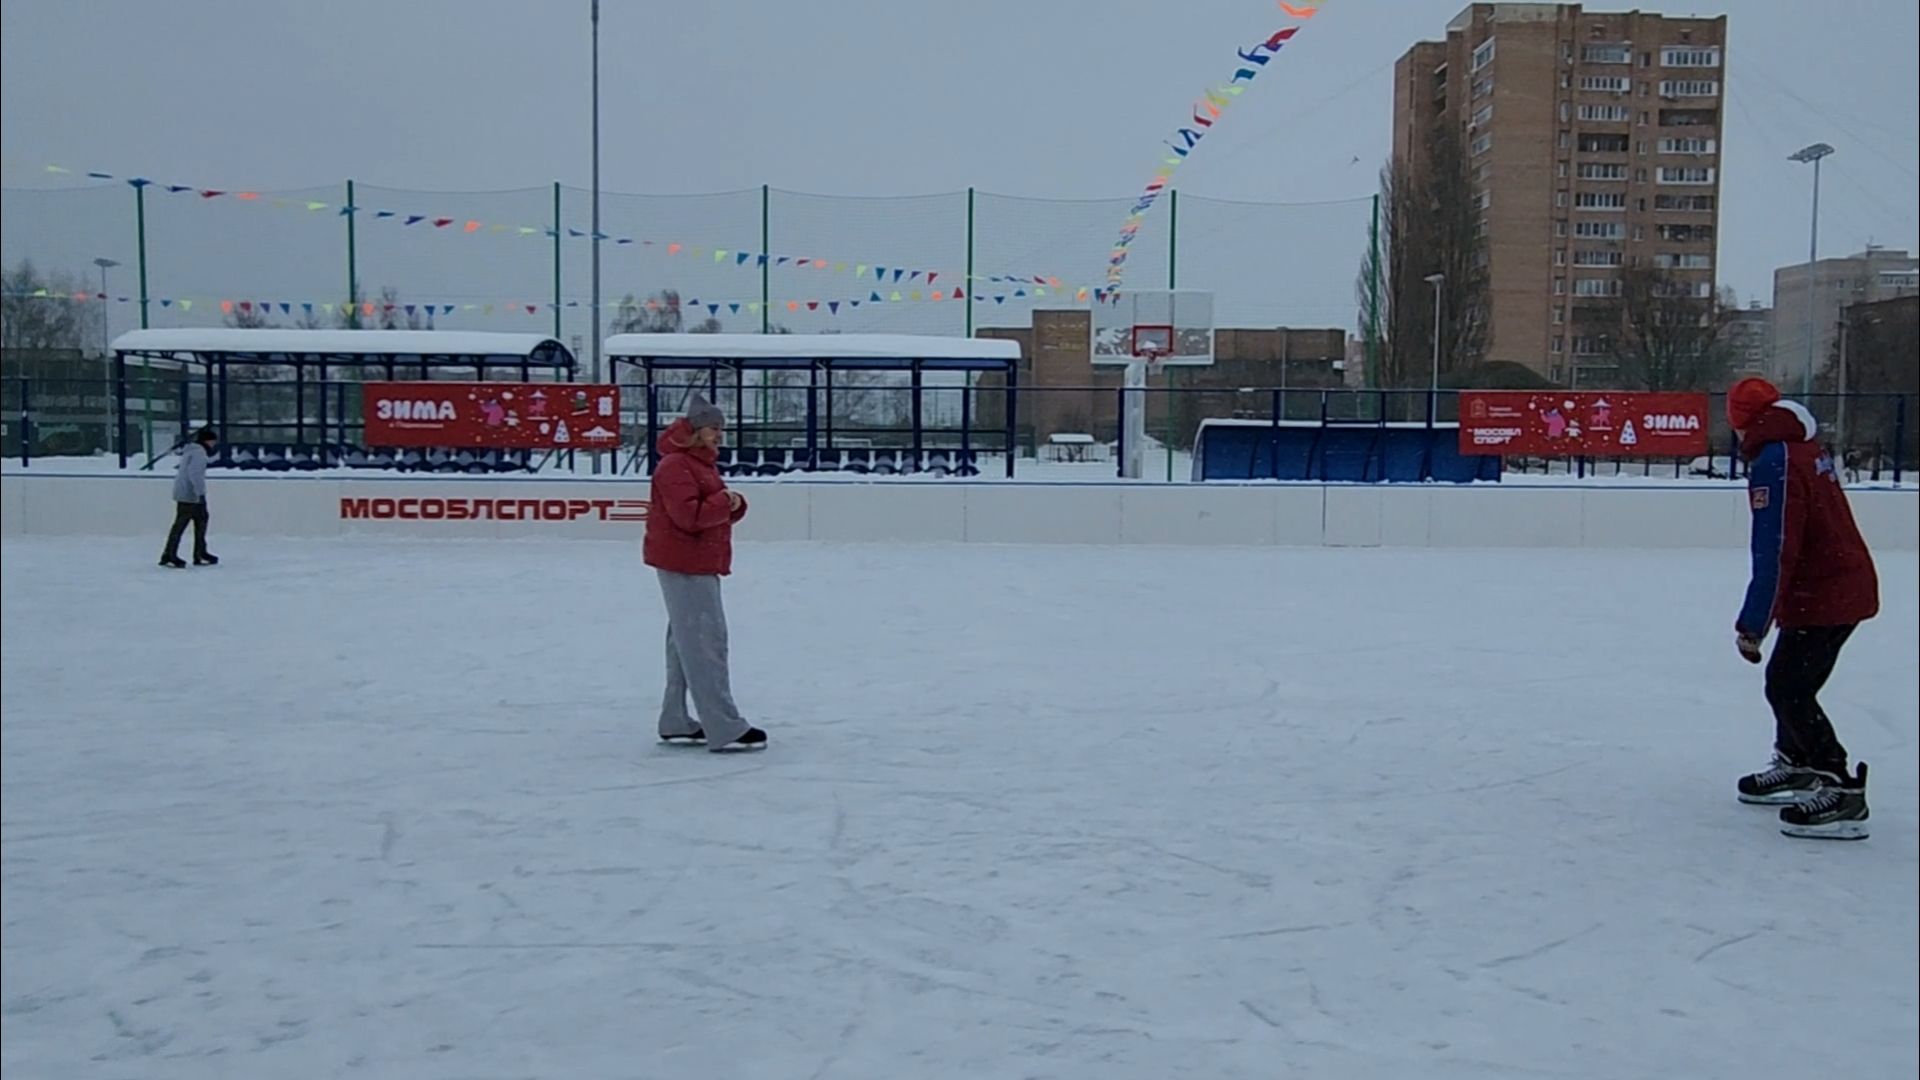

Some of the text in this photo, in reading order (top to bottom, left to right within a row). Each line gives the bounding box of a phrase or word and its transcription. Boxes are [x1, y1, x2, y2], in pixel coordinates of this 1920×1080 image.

[376, 399, 457, 420] ЗИМА
[1643, 414, 1700, 430] ЗИМА
[340, 498, 615, 520] МОСОБЛСПОРТ
